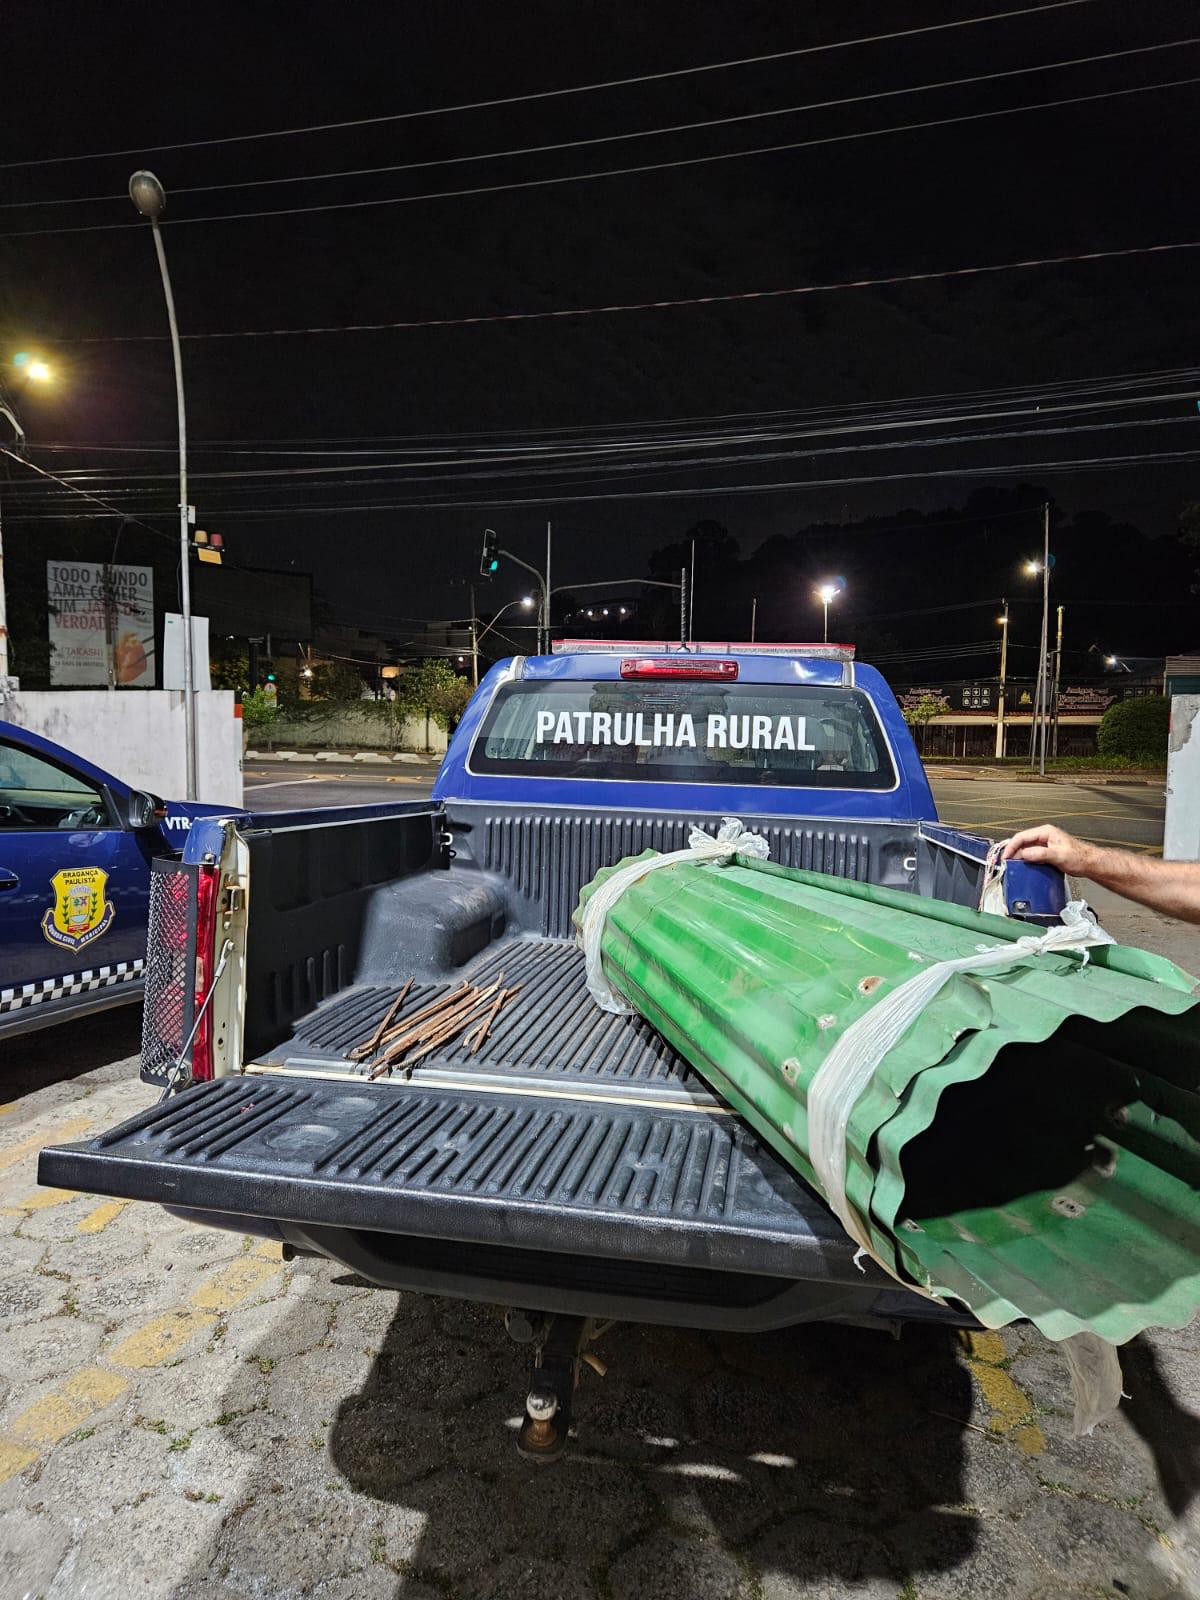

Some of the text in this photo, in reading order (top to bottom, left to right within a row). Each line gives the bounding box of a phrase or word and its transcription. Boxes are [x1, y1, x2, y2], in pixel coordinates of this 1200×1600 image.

[52, 567, 90, 583] TODO
[53, 583, 85, 599] AMA
[83, 600, 119, 615] JAA
[537, 711, 815, 751] PATRULHA RURAL
[62, 869, 98, 879] BRAGANÇA
[65, 877, 96, 885] PAULISTA
